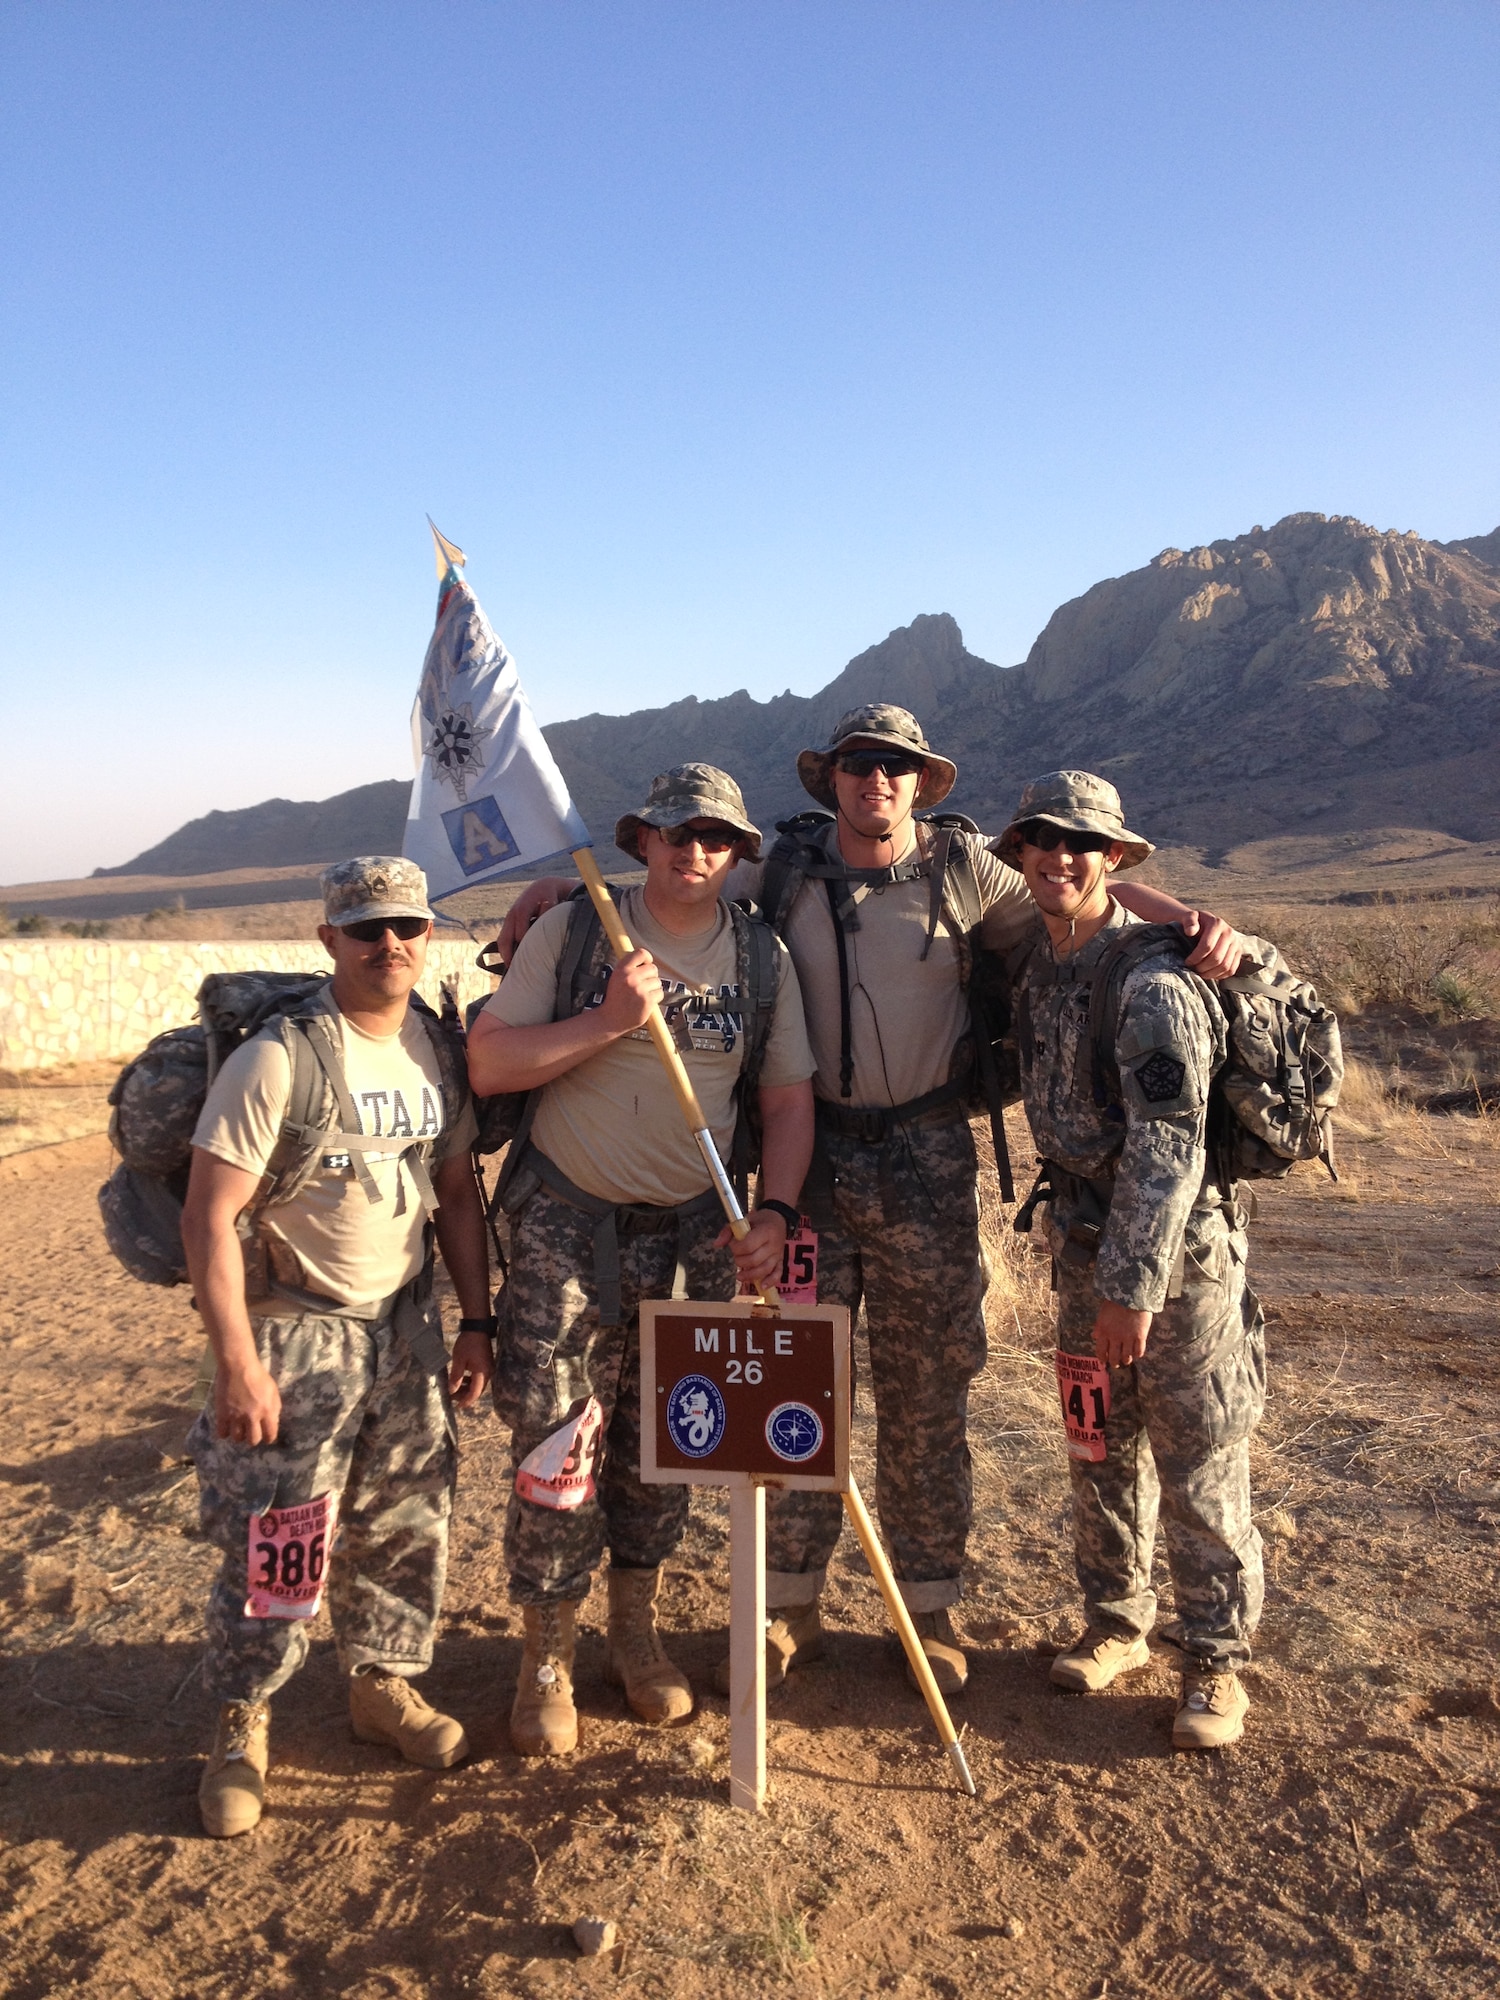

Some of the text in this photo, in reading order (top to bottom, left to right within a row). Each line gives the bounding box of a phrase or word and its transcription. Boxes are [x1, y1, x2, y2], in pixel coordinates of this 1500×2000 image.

[463, 810, 509, 867] A
[350, 1084, 445, 1138] TAA
[694, 1327, 794, 1355] MILE
[725, 1359, 763, 1385] 26
[1067, 1356, 1101, 1372] MEMORIAL
[685, 1377, 713, 1391] BASTARDS
[1070, 1369, 1094, 1385] MARCH
[1070, 1427, 1103, 1441] IDUA
[280, 1507, 311, 1525] BATAAN
[289, 1520, 314, 1538] DEATH
[255, 1533, 325, 1587] 386
